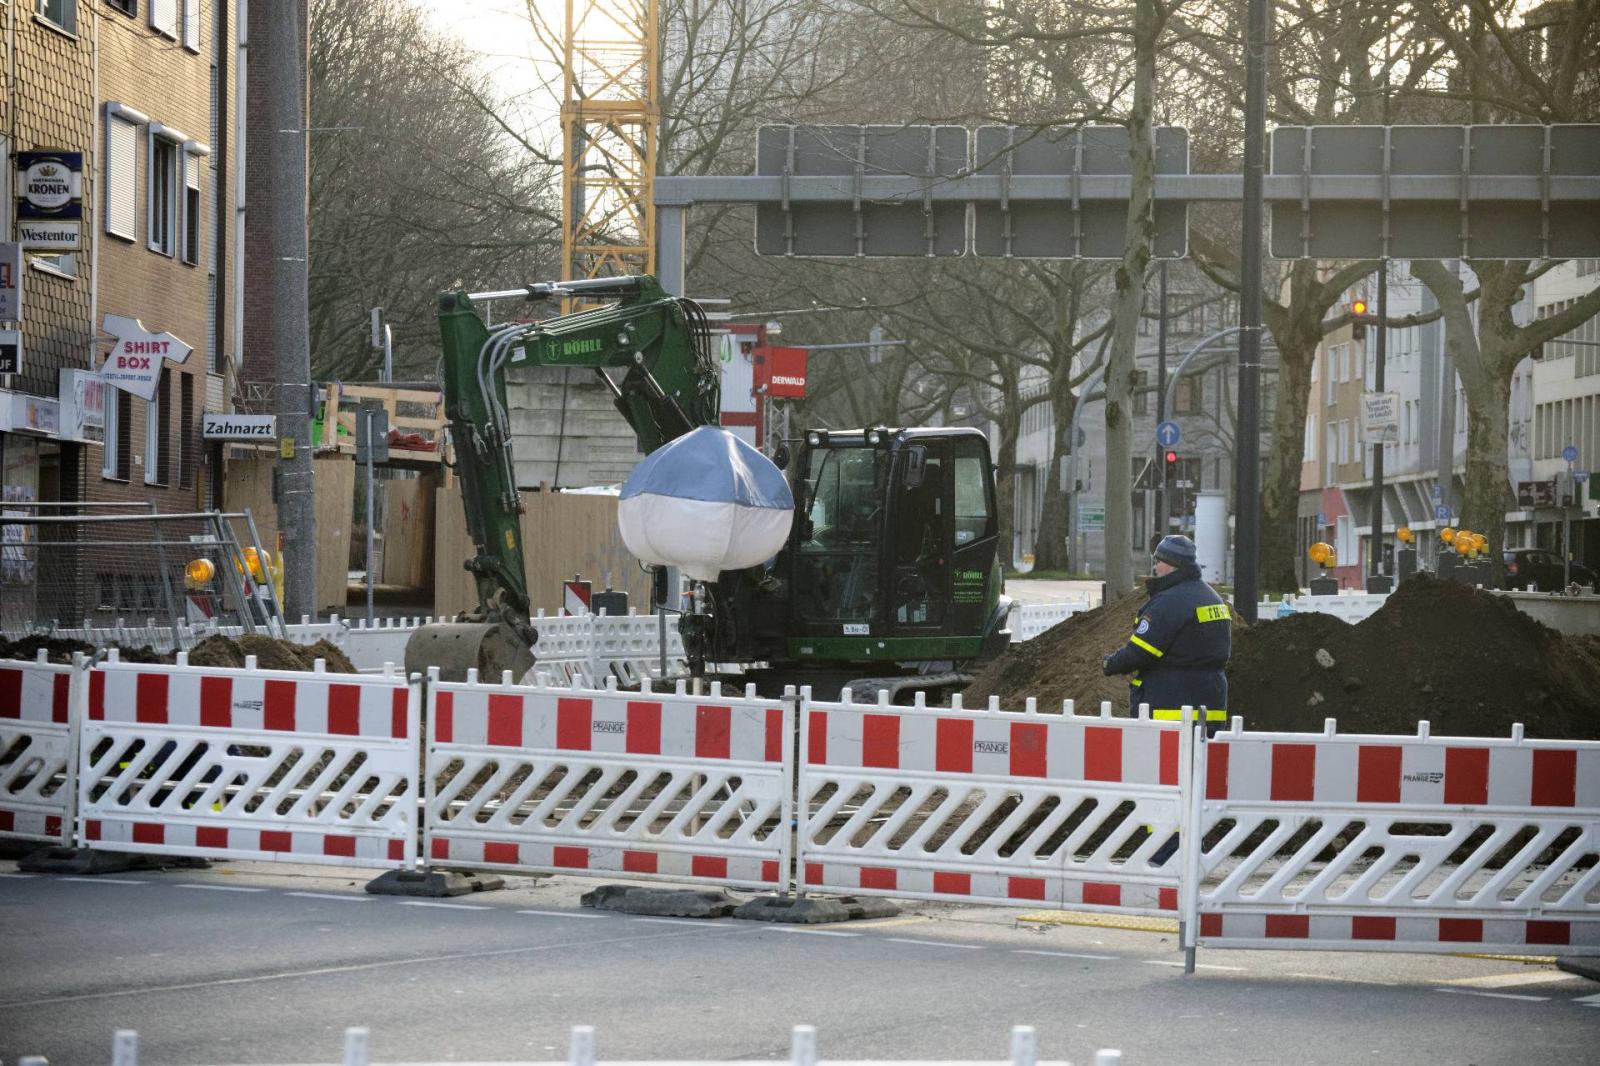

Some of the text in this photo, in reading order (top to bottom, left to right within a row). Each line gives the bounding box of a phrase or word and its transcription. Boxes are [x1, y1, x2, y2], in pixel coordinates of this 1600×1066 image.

[28, 184, 69, 195] KRONEN
[21, 228, 78, 241] Westentor
[123, 341, 170, 354] SHIRT
[117, 356, 150, 370] BOX
[771, 375, 806, 386] DERWALD
[206, 421, 272, 434] Zahnarzt
[975, 742, 1008, 753] PRANGE
[1403, 774, 1429, 783] PRANGE
